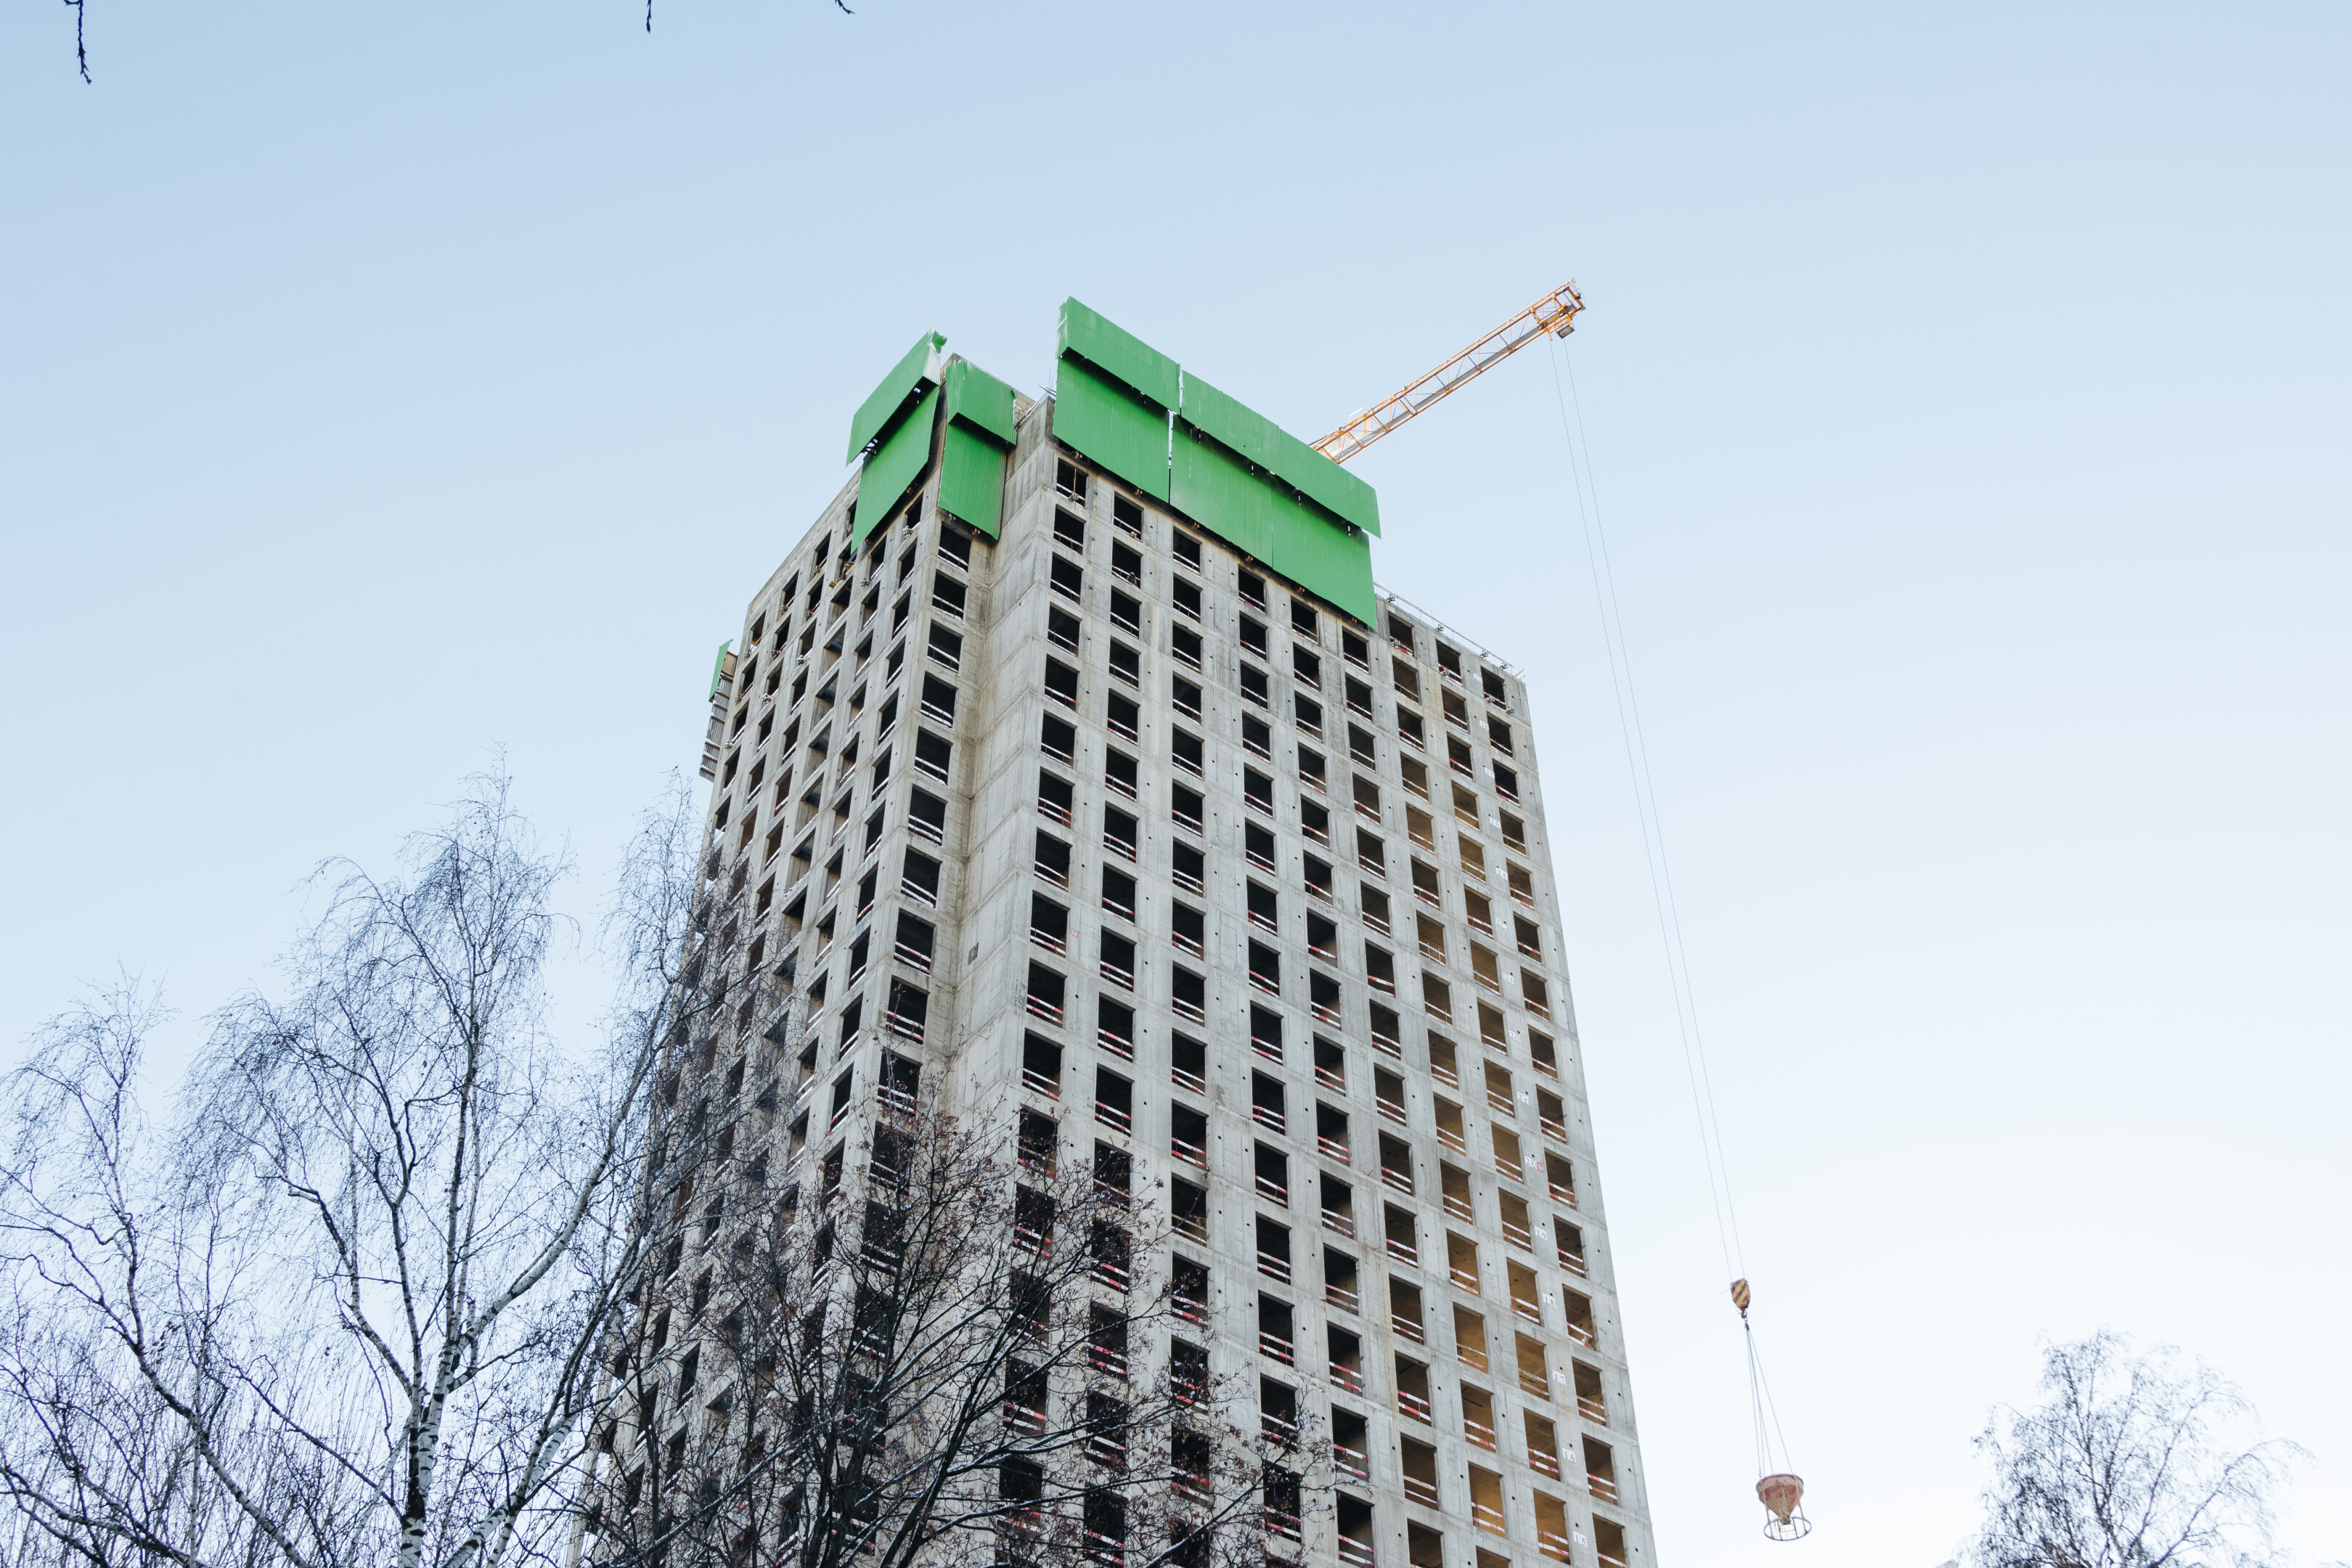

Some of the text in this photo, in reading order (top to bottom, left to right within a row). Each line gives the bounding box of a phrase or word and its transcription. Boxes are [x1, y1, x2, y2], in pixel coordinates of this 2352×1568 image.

[1518, 1093, 1527, 1103] 21
[1536, 1229, 1545, 1239] 19
[1545, 1297, 1555, 1307] 18
[1554, 1373, 1564, 1384] 17
[1564, 1451, 1575, 1461] 16
[1576, 1535, 1585, 1545] 15
